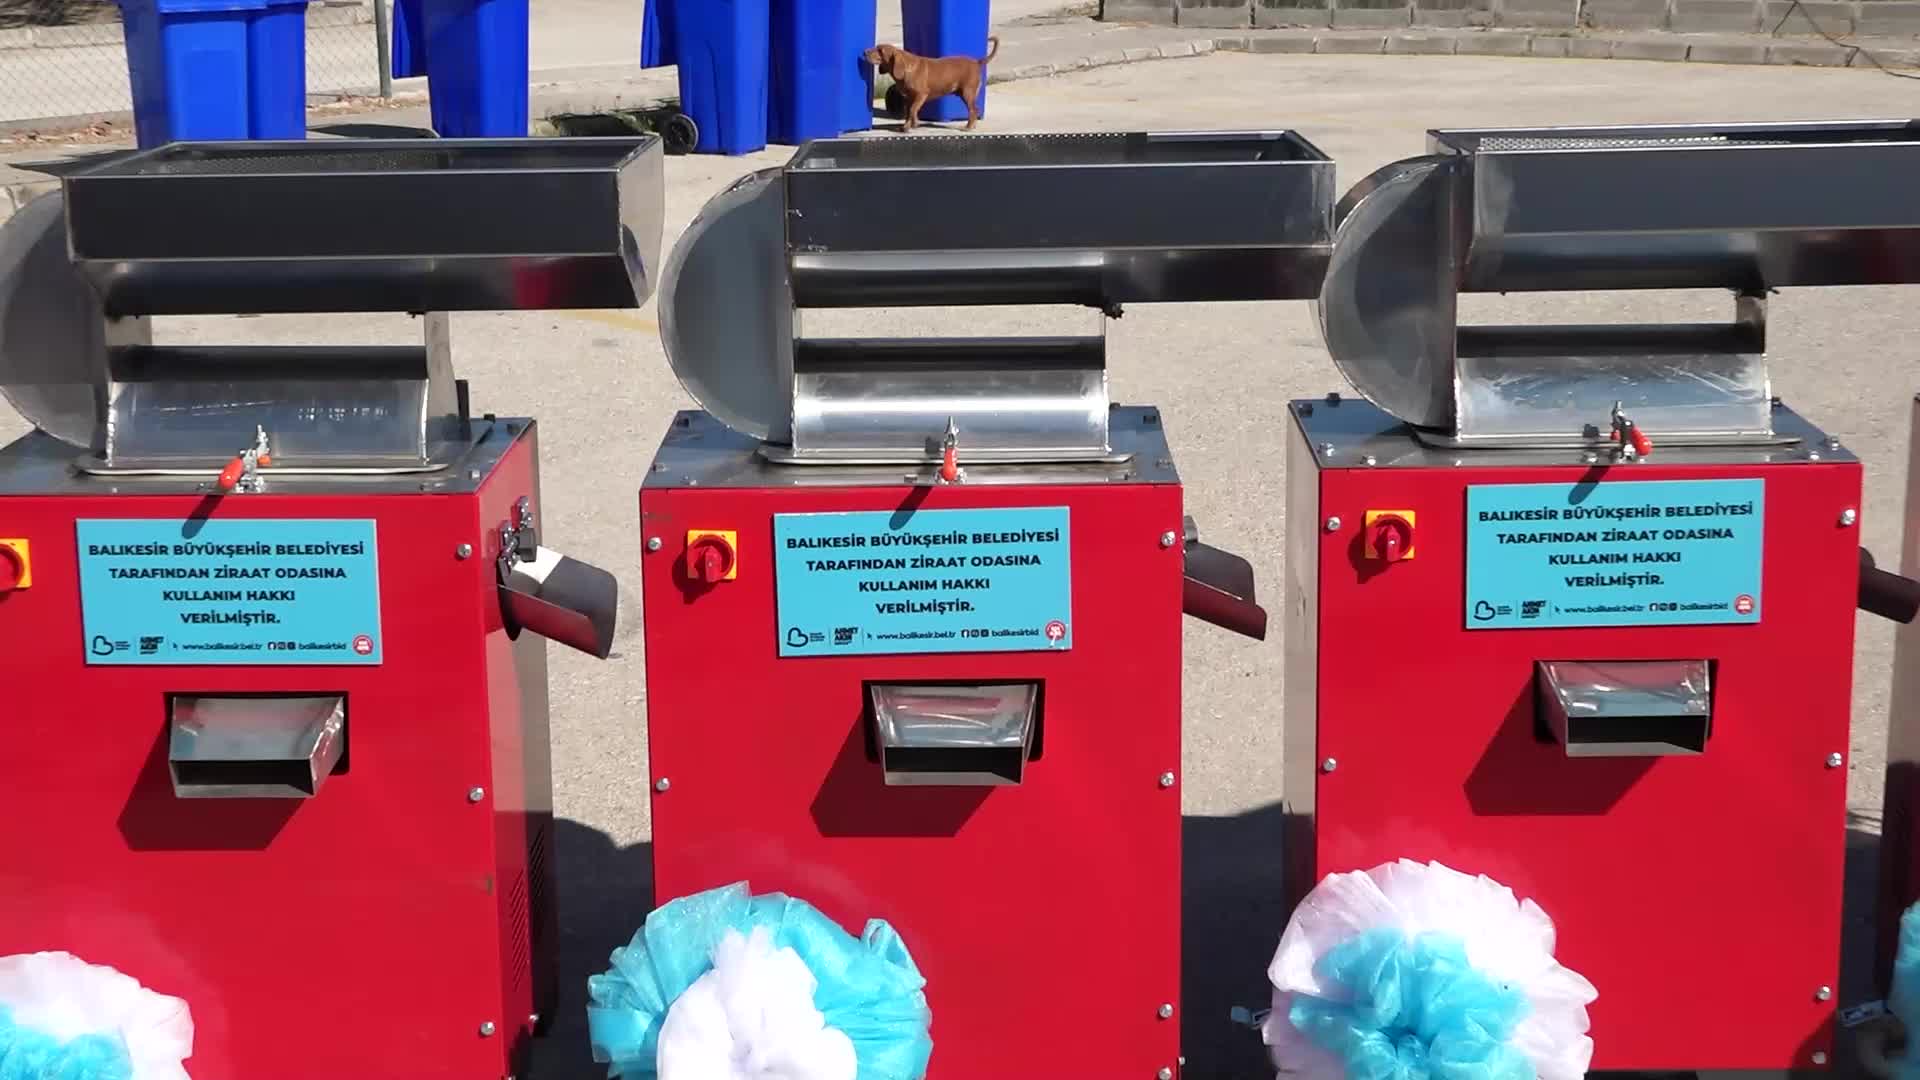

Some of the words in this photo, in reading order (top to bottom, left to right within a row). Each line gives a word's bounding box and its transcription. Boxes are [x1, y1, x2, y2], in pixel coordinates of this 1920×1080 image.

[1479, 507, 1558, 521] BALIKESİR
[1563, 506, 1661, 521] BÜYÜKŞEHİR
[1665, 502, 1752, 517] BELEDİYESİ
[787, 533, 866, 548] BALIKESİR
[871, 530, 967, 548] BÜYÜKŞEHİR
[972, 529, 1059, 544] BELEDİYESİ
[1497, 532, 1597, 544] TARAFINDAN
[1602, 528, 1659, 541] ZİRAAT
[1663, 528, 1734, 540] ODASINA
[89, 542, 168, 555] BALIKESİR
[173, 541, 271, 558] BÜYÜKŞEHİR
[276, 541, 363, 555] BELEDİYESİ
[806, 559, 905, 571] TARAFINDAN
[910, 554, 966, 568] ZİRAAT
[972, 555, 1041, 567] ODASINA
[1549, 554, 1628, 565] KULLANIM
[1633, 552, 1680, 563] HAKKI
[109, 568, 209, 578] TARAFINDAN
[214, 565, 271, 578] ZİRAAT
[275, 568, 347, 578] ODASINA
[859, 580, 937, 592] KULLANIM
[942, 579, 989, 589] HAKKI
[1565, 573, 1664, 588] VERİLMİŞTİR.
[163, 591, 242, 601] KULLANIM
[247, 591, 295, 601] HAKKI
[876, 599, 974, 615] VERİLMİŞTİR.
[180, 611, 280, 626] VERİLMİŞTİR.
